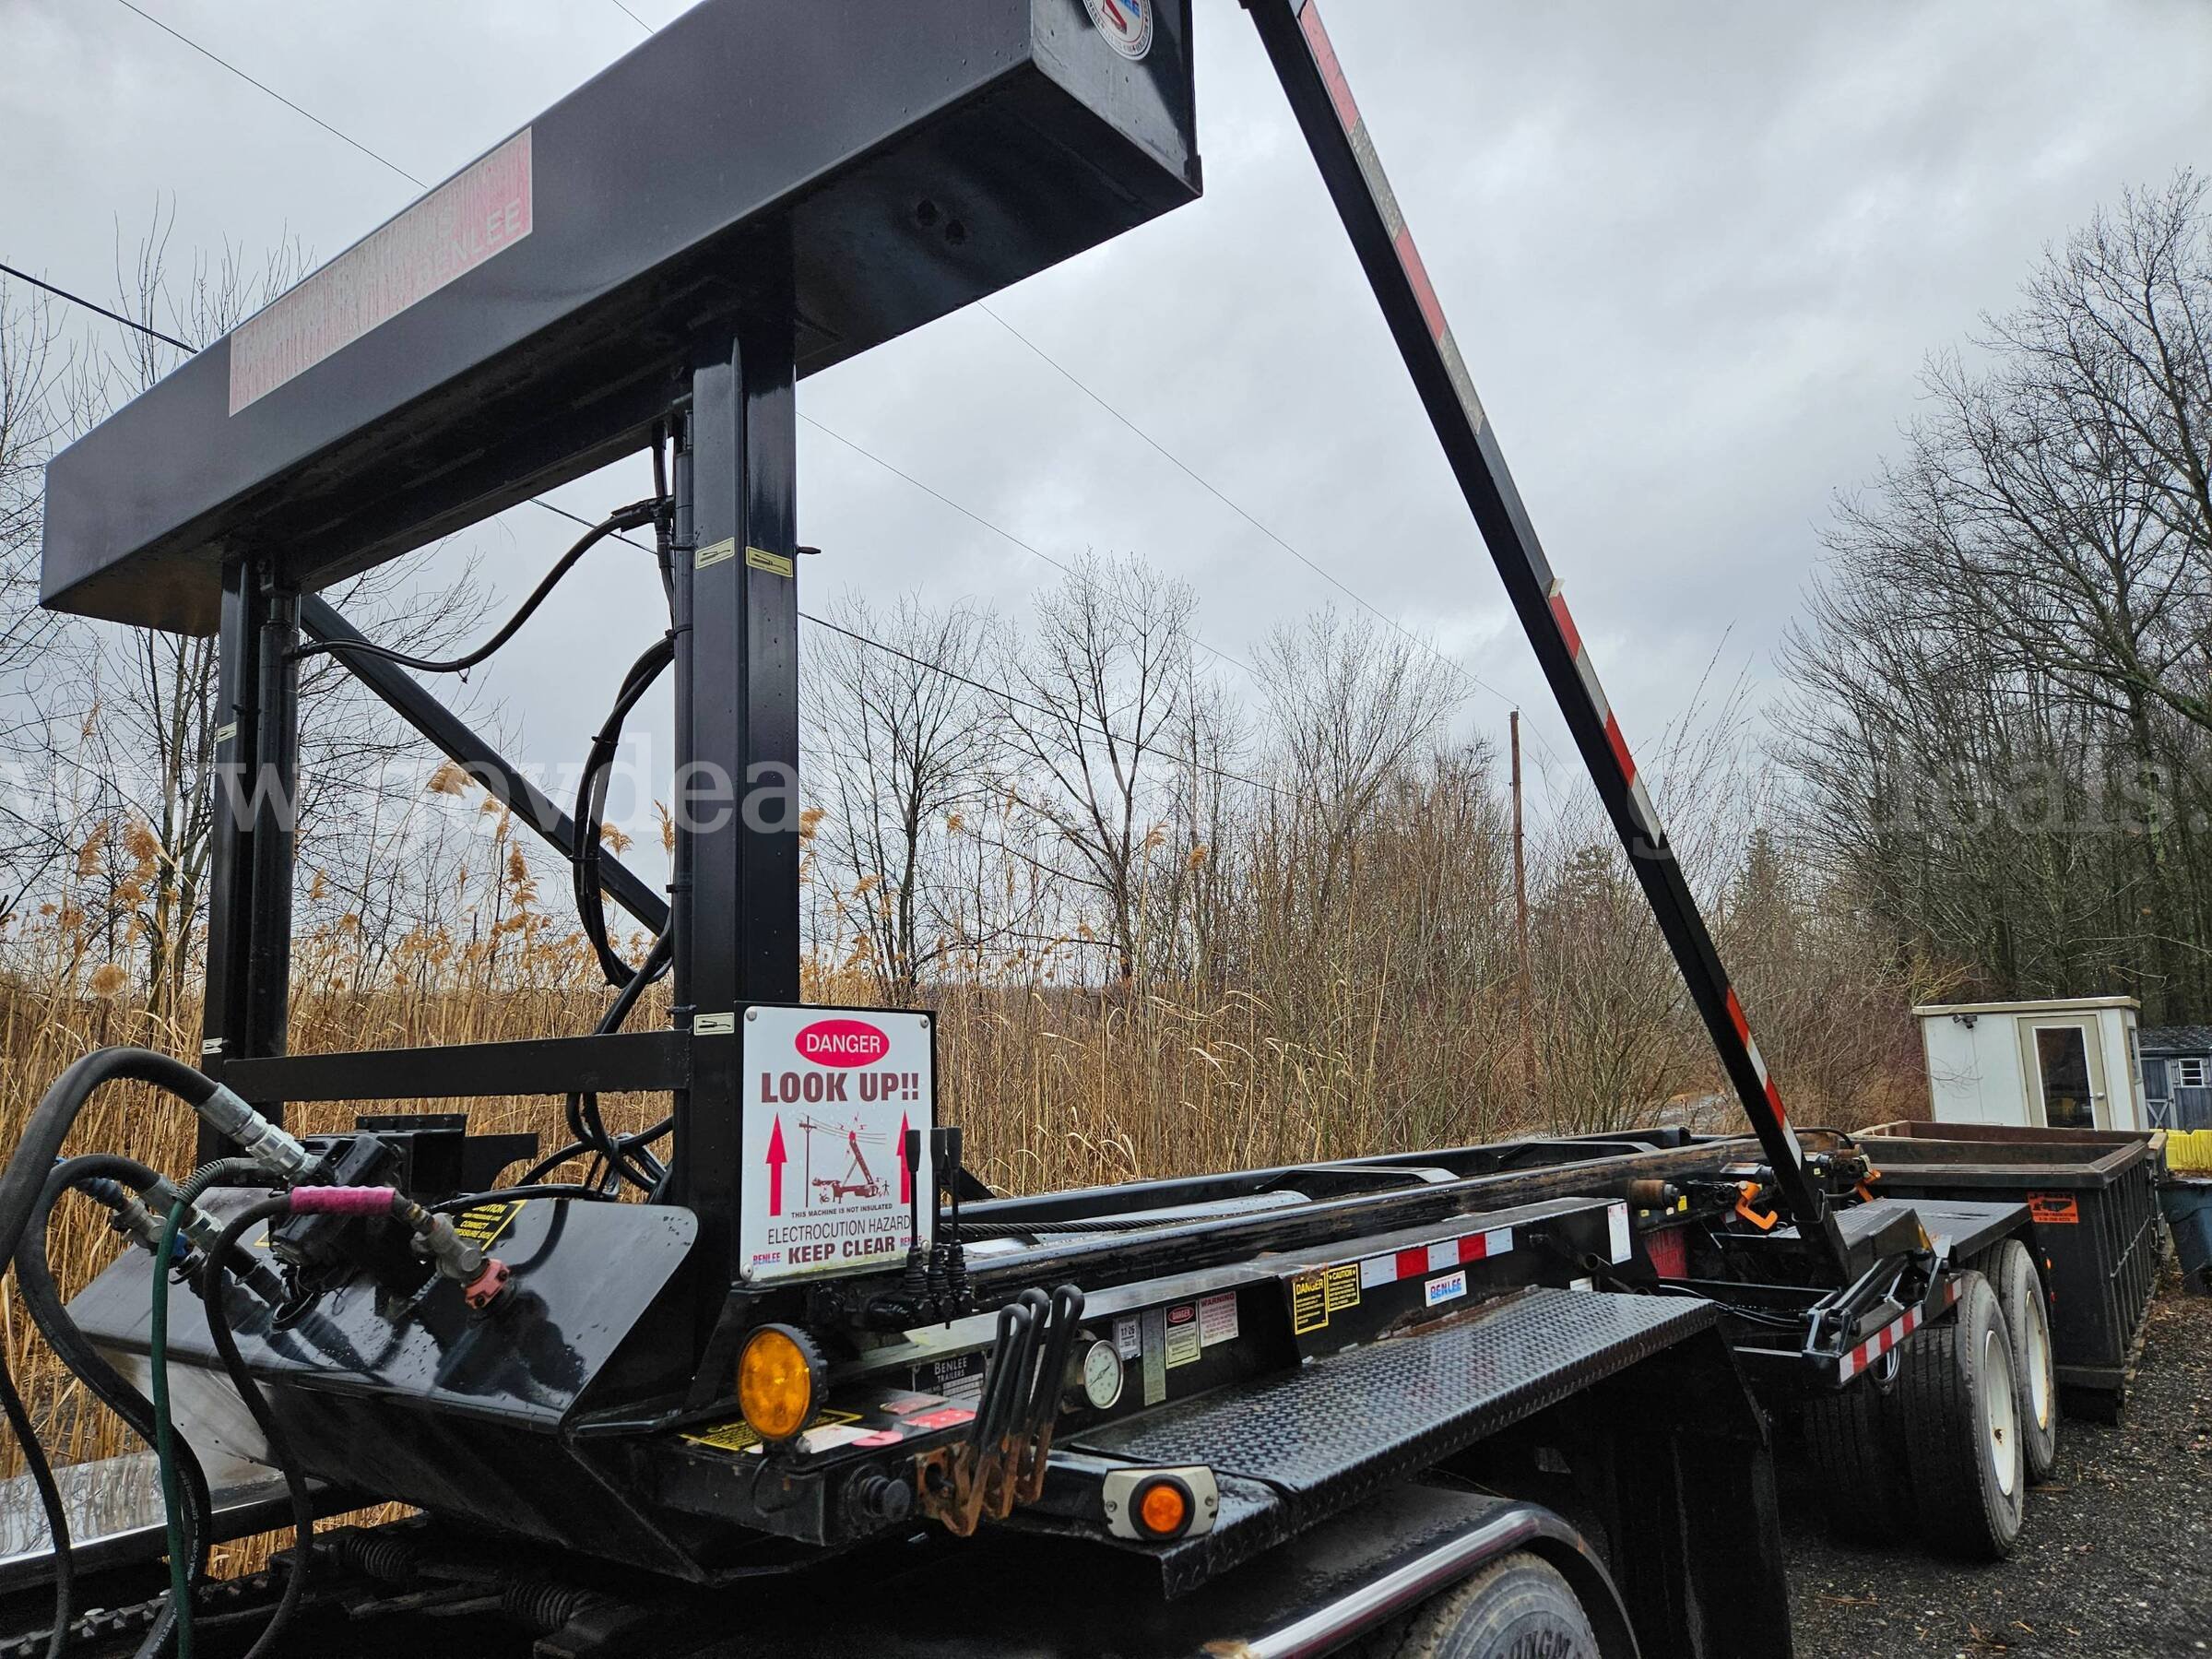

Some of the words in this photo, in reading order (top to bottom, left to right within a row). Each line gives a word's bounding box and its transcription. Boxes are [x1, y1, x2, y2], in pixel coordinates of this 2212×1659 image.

[806, 1033, 881, 1054] DANGER
[761, 1072, 847, 1104] LOOK
[859, 1072, 919, 1102] UP!!
[808, 1209, 838, 1217] MACHINE
[859, 1203, 893, 1213] INSULATED
[767, 1220, 866, 1245] ELECTROCUTION
[869, 1215, 911, 1234] HAZARD
[752, 1251, 781, 1266] BENLEE
[788, 1243, 835, 1264] KEEP
[842, 1236, 895, 1258] CLEAR
[1295, 1279, 1323, 1294] DANGER
[1201, 1293, 1235, 1308] WARNING
[934, 1357, 967, 1375] BENLEE
[937, 1369, 965, 1382] TRAILERS
